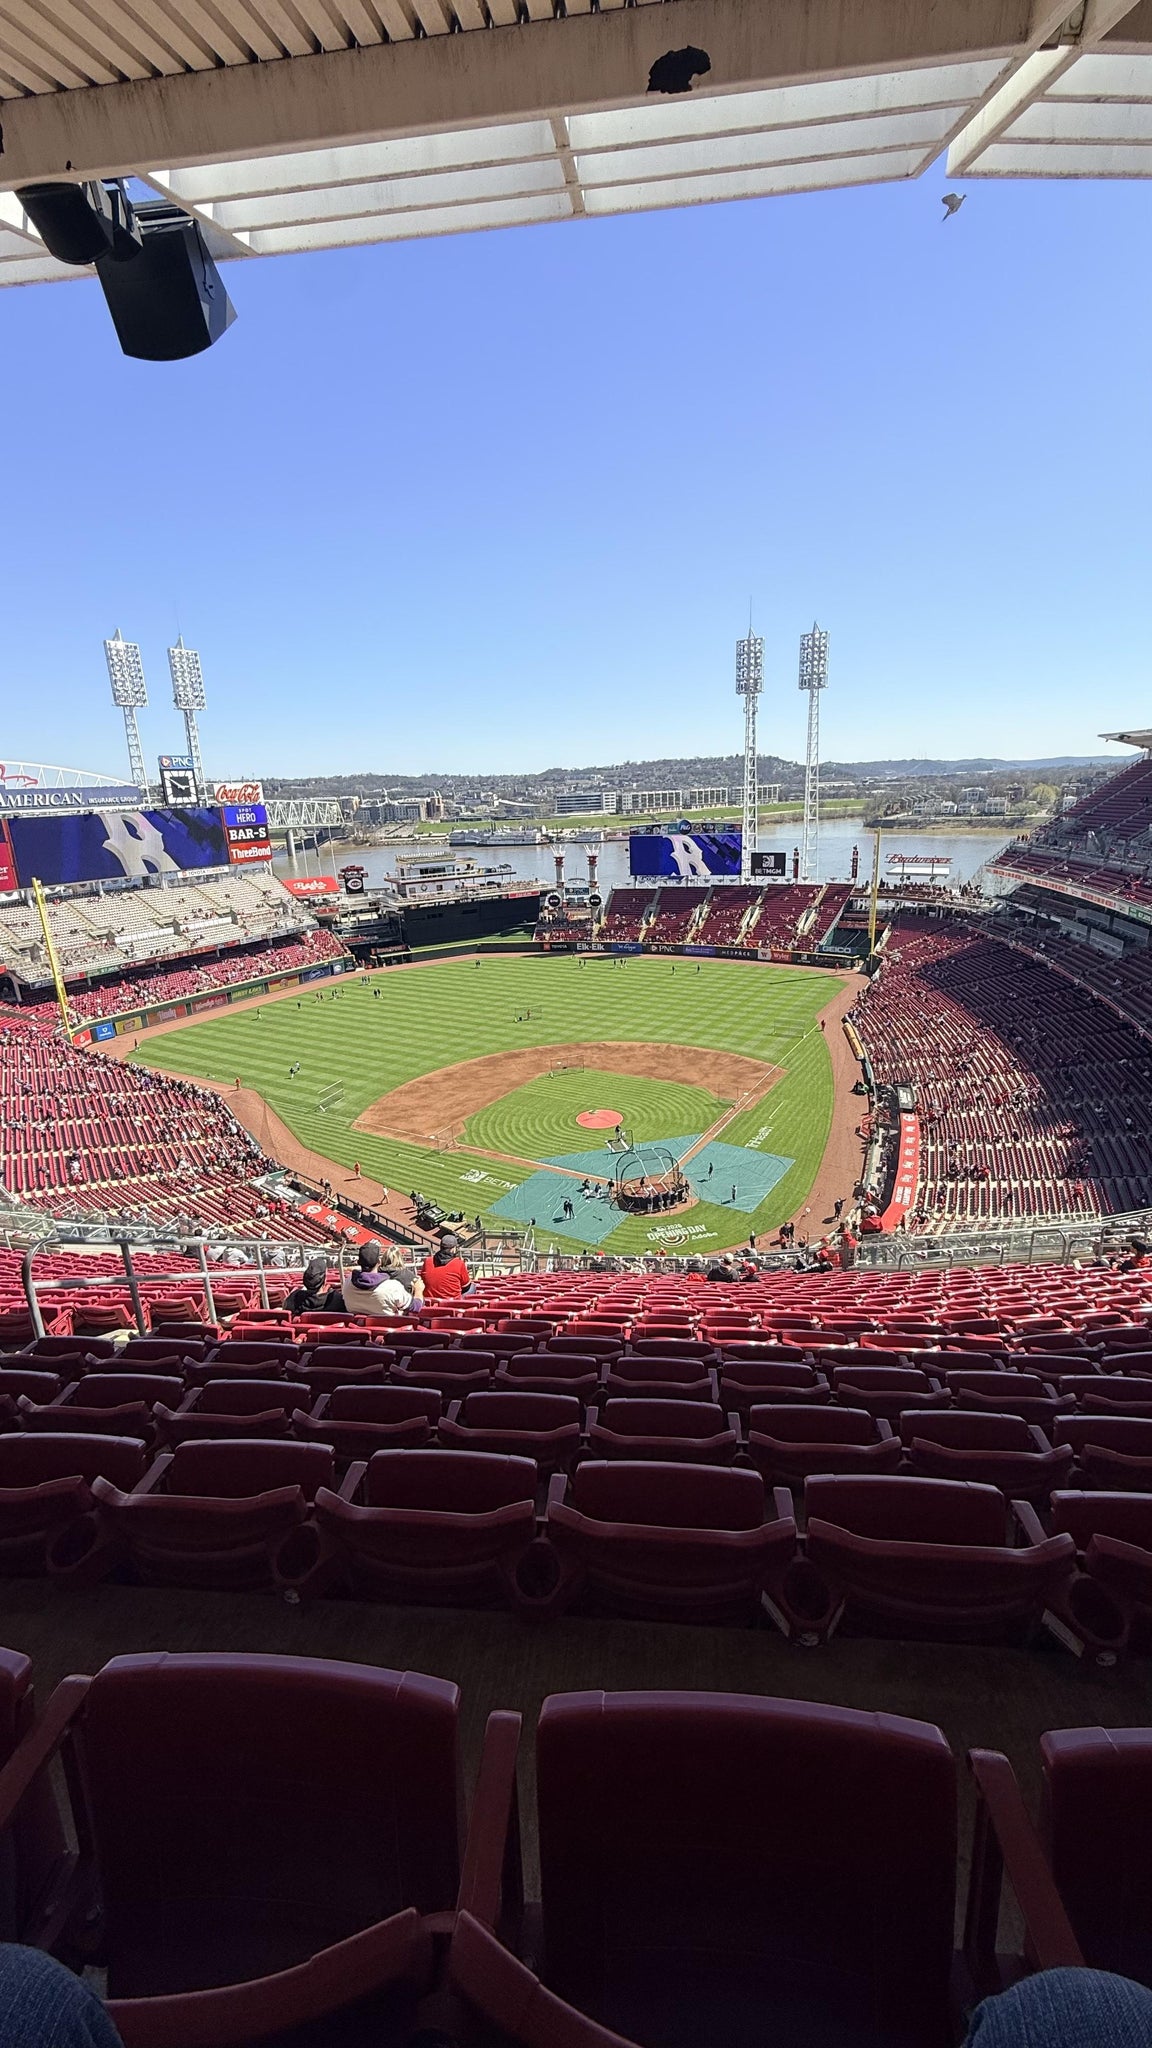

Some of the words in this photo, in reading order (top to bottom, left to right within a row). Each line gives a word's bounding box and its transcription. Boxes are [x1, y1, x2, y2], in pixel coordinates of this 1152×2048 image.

[172, 757, 193, 767] PNC
[216, 784, 260, 803] Coca-Cola
[236, 813, 256, 823] HERO
[229, 827, 266, 840] BAR-S
[231, 846, 271, 859] ThreeBond
[293, 880, 327, 890] Reds
[647, 1227, 689, 1241] OPENING
[687, 1224, 707, 1234] DAY
[692, 1232, 718, 1240] Adobe
